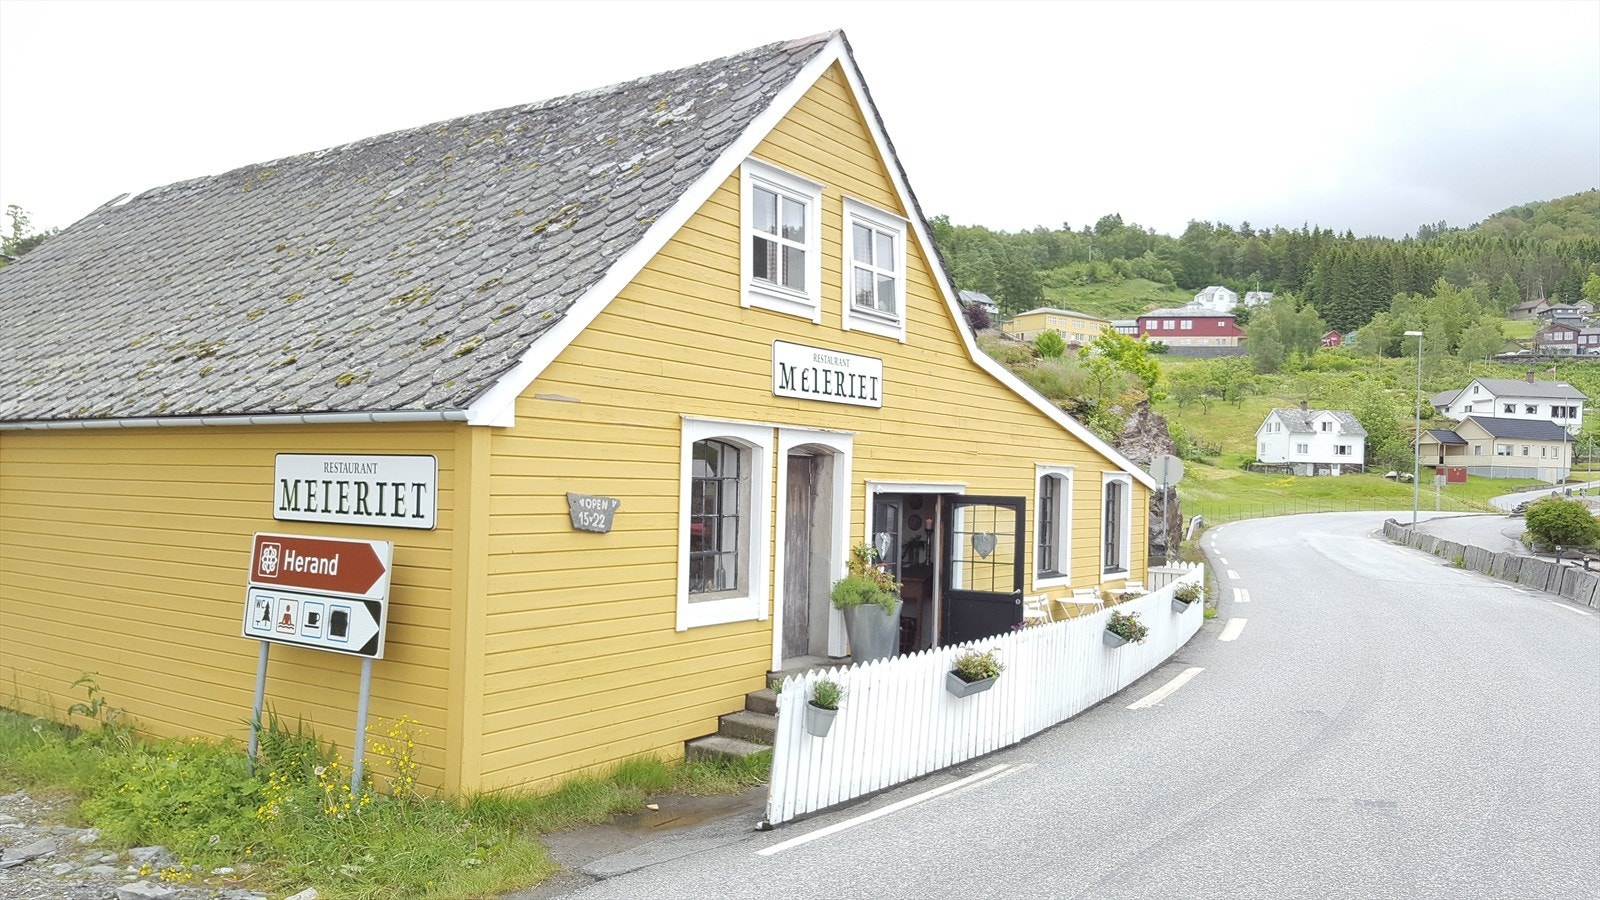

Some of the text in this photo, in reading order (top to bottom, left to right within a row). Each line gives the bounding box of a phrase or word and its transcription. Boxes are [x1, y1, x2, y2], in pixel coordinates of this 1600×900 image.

[813, 353, 850, 367] RESTAURANT
[323, 461, 378, 474] RESTAURANT
[279, 478, 426, 518] MEIERIET
[585, 498, 608, 510] OPEN
[283, 549, 339, 576] Herand
